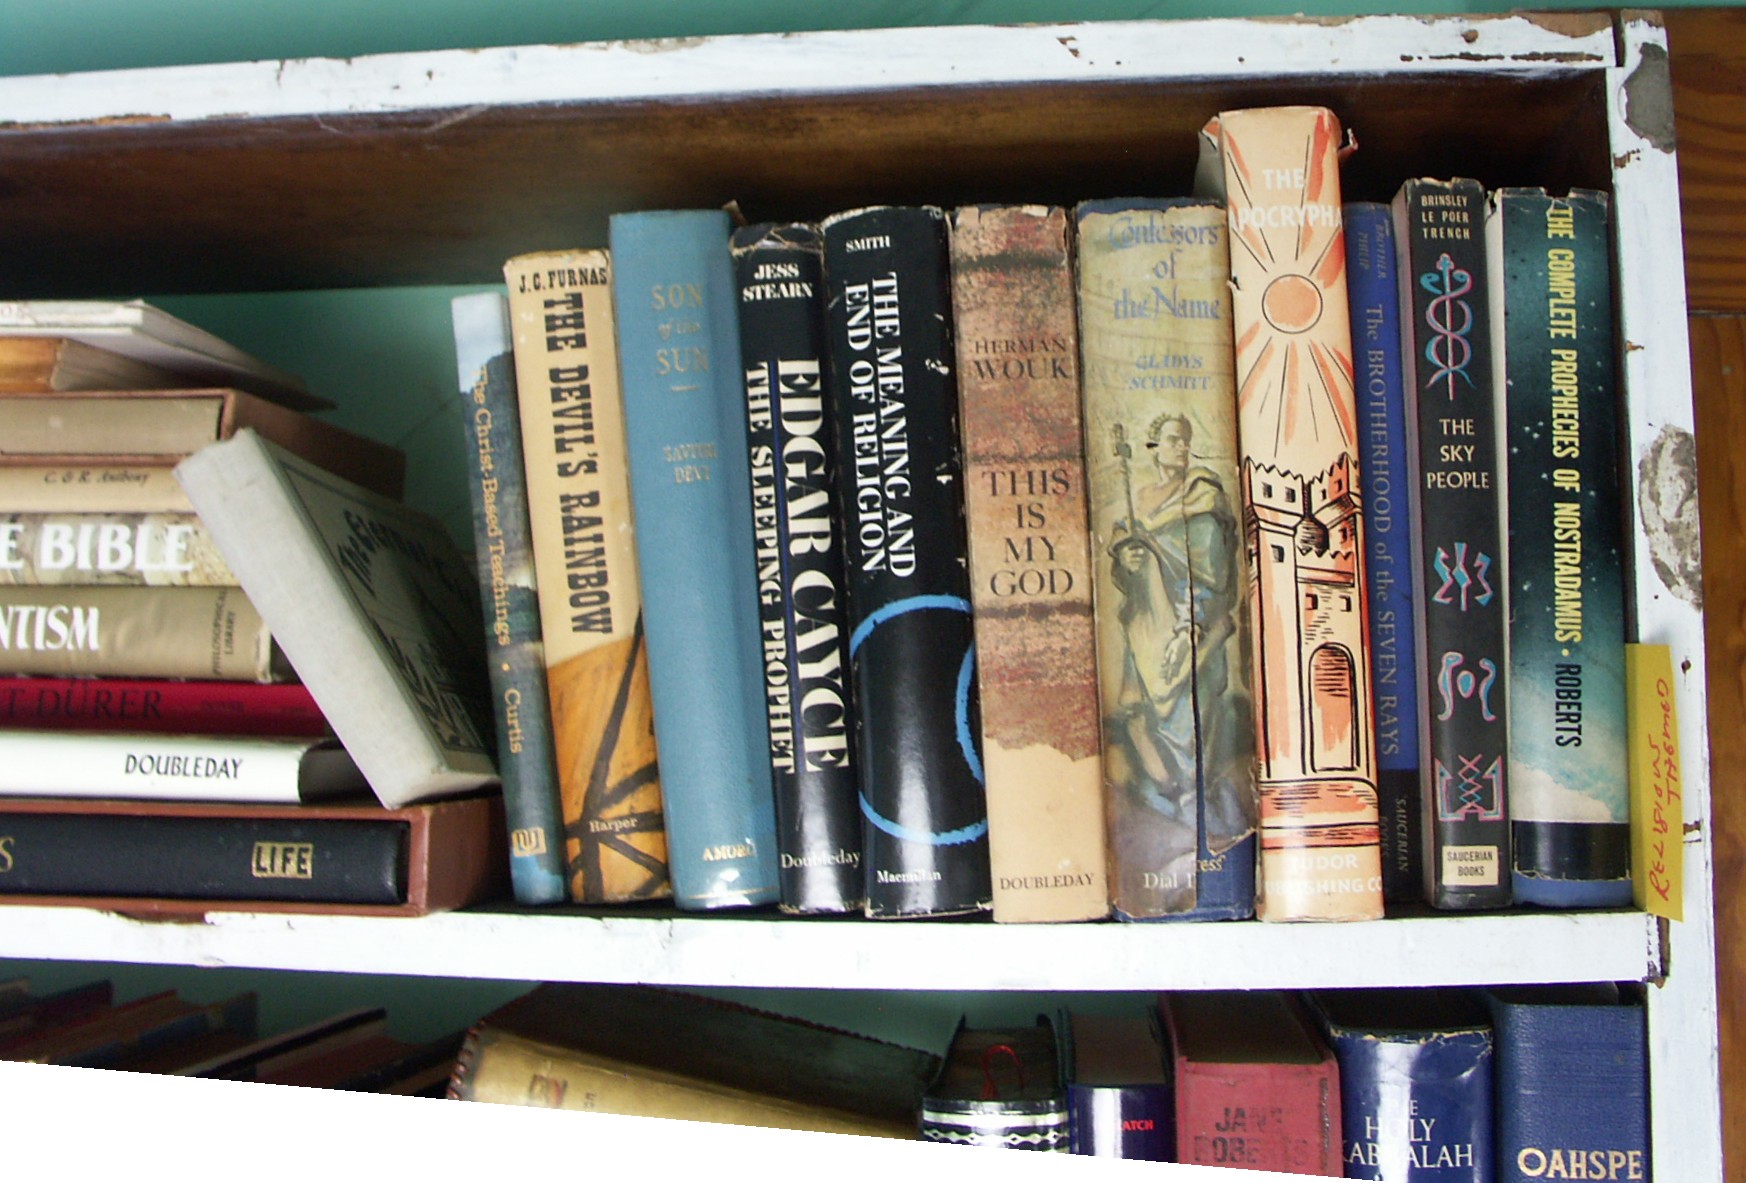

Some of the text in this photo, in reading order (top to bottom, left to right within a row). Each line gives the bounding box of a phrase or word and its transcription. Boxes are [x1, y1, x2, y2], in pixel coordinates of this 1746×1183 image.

[1262, 167, 1306, 190] THE
[1421, 194, 1468, 207] BRINSLEY
[1422, 211, 1469, 223] LE POER
[846, 235, 891, 252] SMITH
[1423, 227, 1471, 240] TRENCH
[754, 263, 799, 280] JESS
[1152, 249, 1182, 280] of
[547, 267, 608, 290] FURNAS
[651, 284, 704, 311] SON
[742, 282, 813, 303] STEARN
[974, 337, 1067, 356] HERMAN
[656, 347, 709, 376] SUN
[973, 357, 1069, 380] WOUK
[845, 282, 887, 573] END OF RELIGION
[872, 271, 917, 577] THE MEANING AND
[1439, 418, 1475, 436] THE
[1546, 205, 1583, 644] THE COMPLETE PROPHECIES OF NOSTRADAMUS
[544, 292, 614, 634] THE DEVIL'S RAINBOW
[1440, 445, 1475, 462] SKY
[981, 467, 1071, 498] THIS
[1426, 471, 1489, 489] PEOPLE
[1016, 502, 1047, 529] IS
[1365, 303, 1398, 755] The BROTHERHOOD of the SEVEN RAYS
[40, 523, 195, 571] BIBLE
[1004, 535, 1064, 564] MY
[746, 361, 796, 775] THE SLEEPING PROPHET
[778, 357, 850, 773] EDGAR CAYCE
[488, 539, 511, 646] Teachings
[989, 567, 1074, 598] GOD
[1554, 663, 1583, 748] ROBERTS
[504, 687, 523, 755] Curtis
[124, 752, 243, 780] DOUBLEDAY
[589, 815, 638, 834] Harper
[253, 843, 312, 877] LIFE
[781, 847, 860, 869] Doubleday
[1447, 849, 1494, 863] SAUCERIAN
[999, 872, 1095, 892] DOUBLEDAY
[1143, 871, 1178, 889] Dial
[1458, 865, 1485, 877] BOOKS
[1517, 1146, 1644, 1180] OAHSPE
